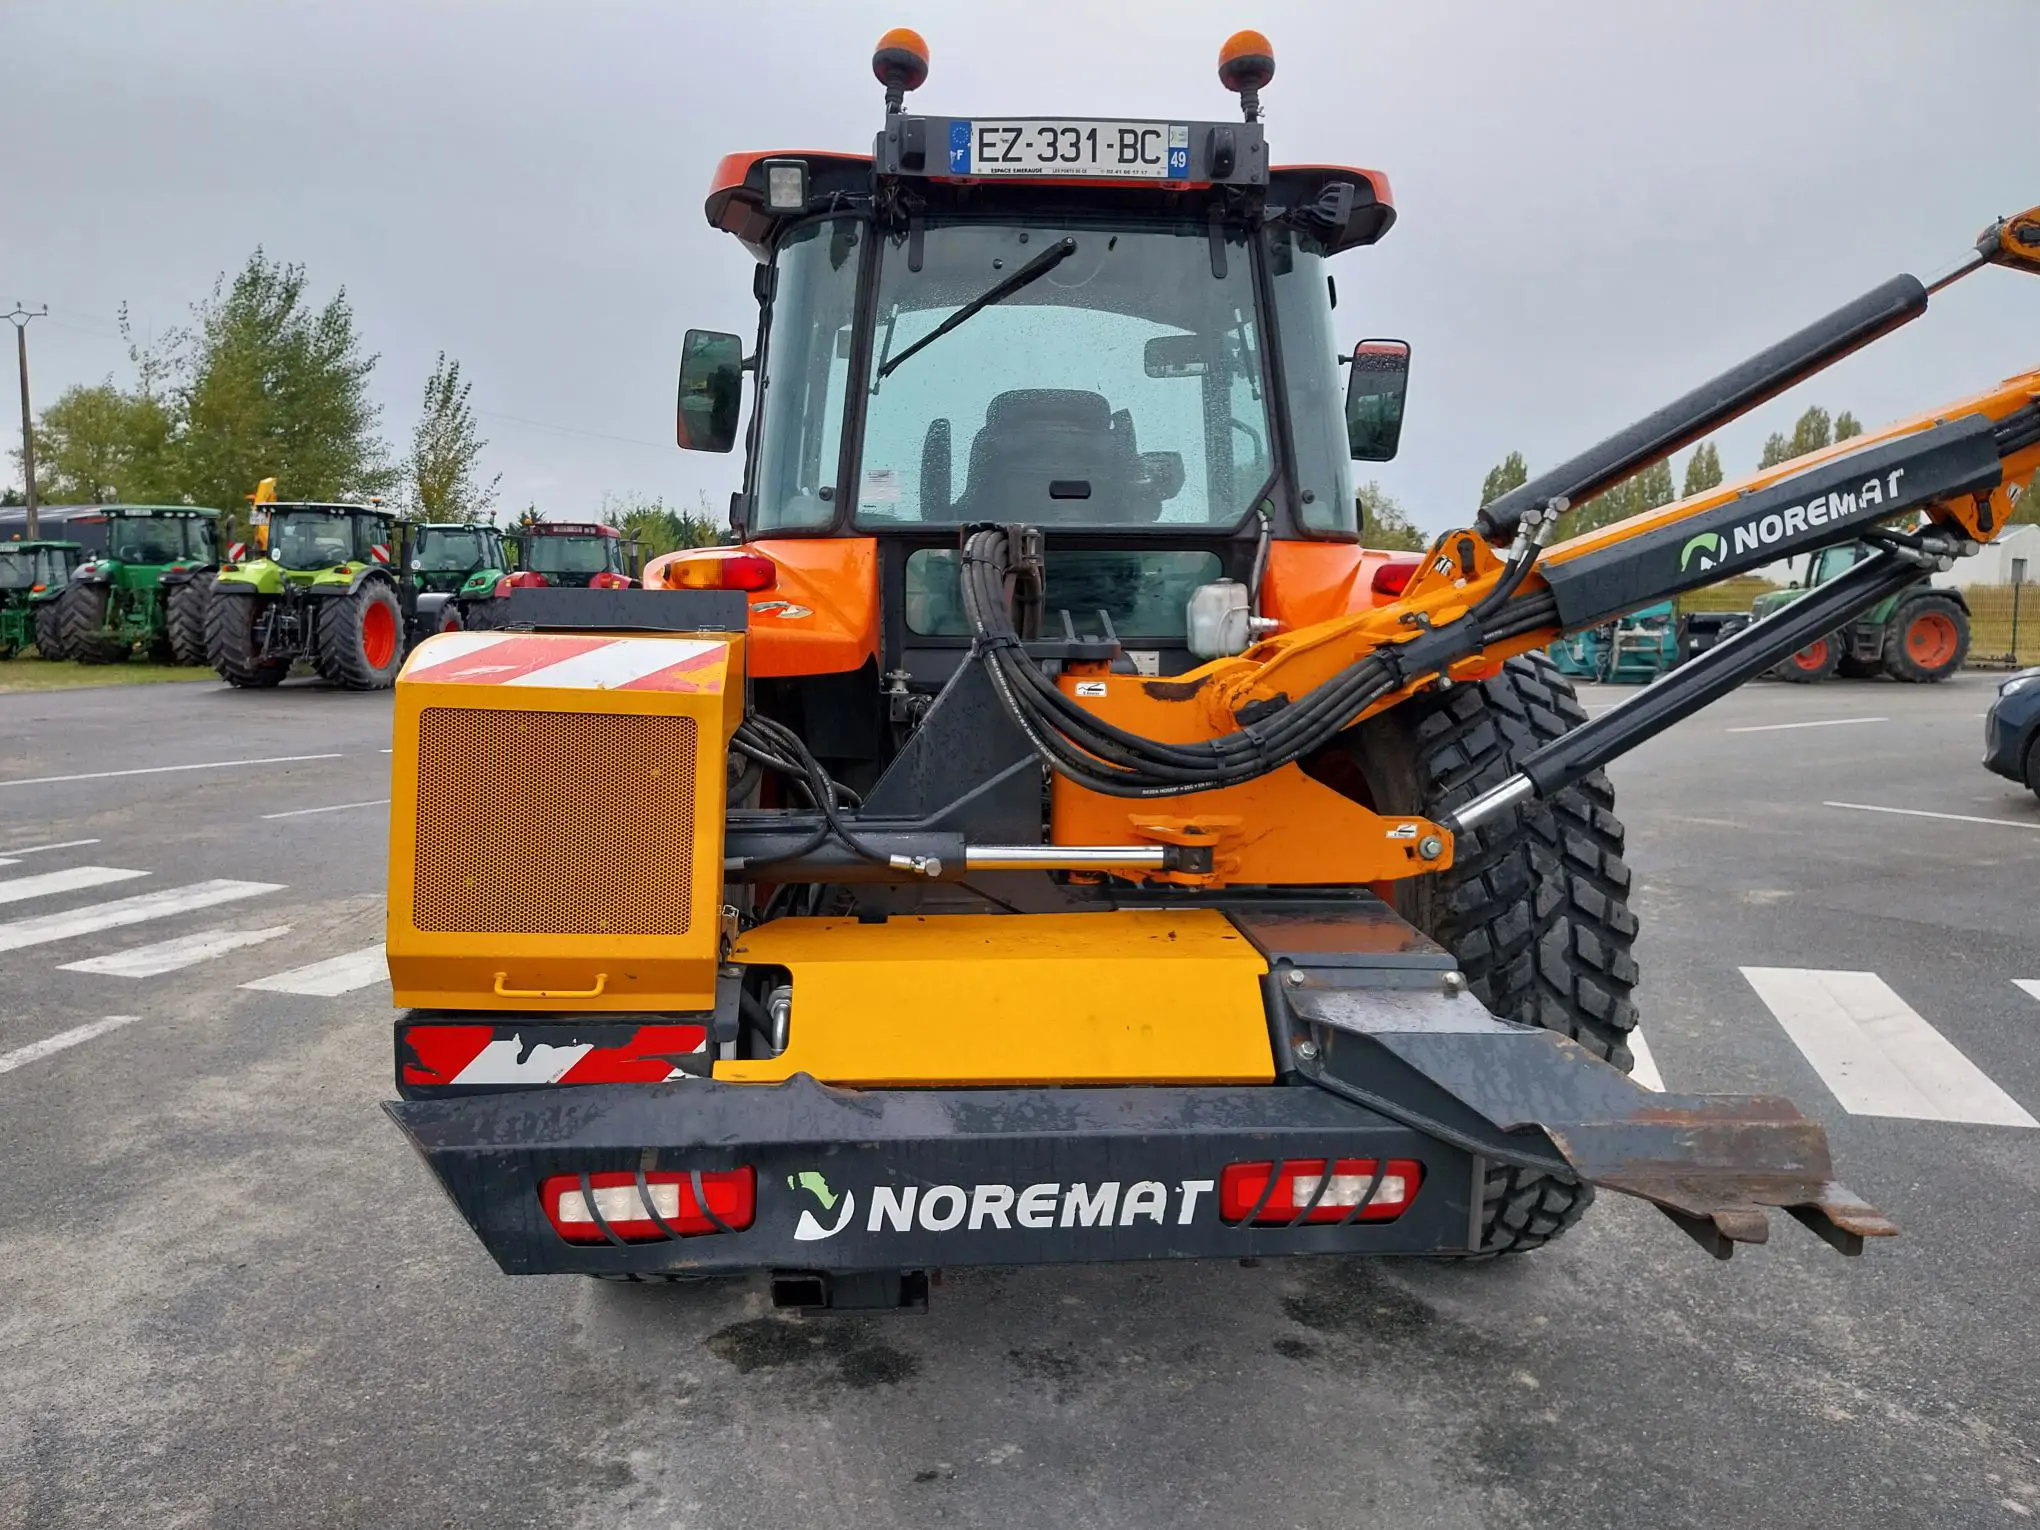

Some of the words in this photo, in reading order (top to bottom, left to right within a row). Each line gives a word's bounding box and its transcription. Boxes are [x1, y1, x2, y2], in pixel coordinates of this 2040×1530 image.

[957, 150, 964, 160] F
[979, 127, 1161, 164] EZ-331-BC
[1170, 151, 1186, 168] 49
[1733, 468, 1904, 554] NOREMAT
[867, 1179, 1215, 1232] NOREMAT
